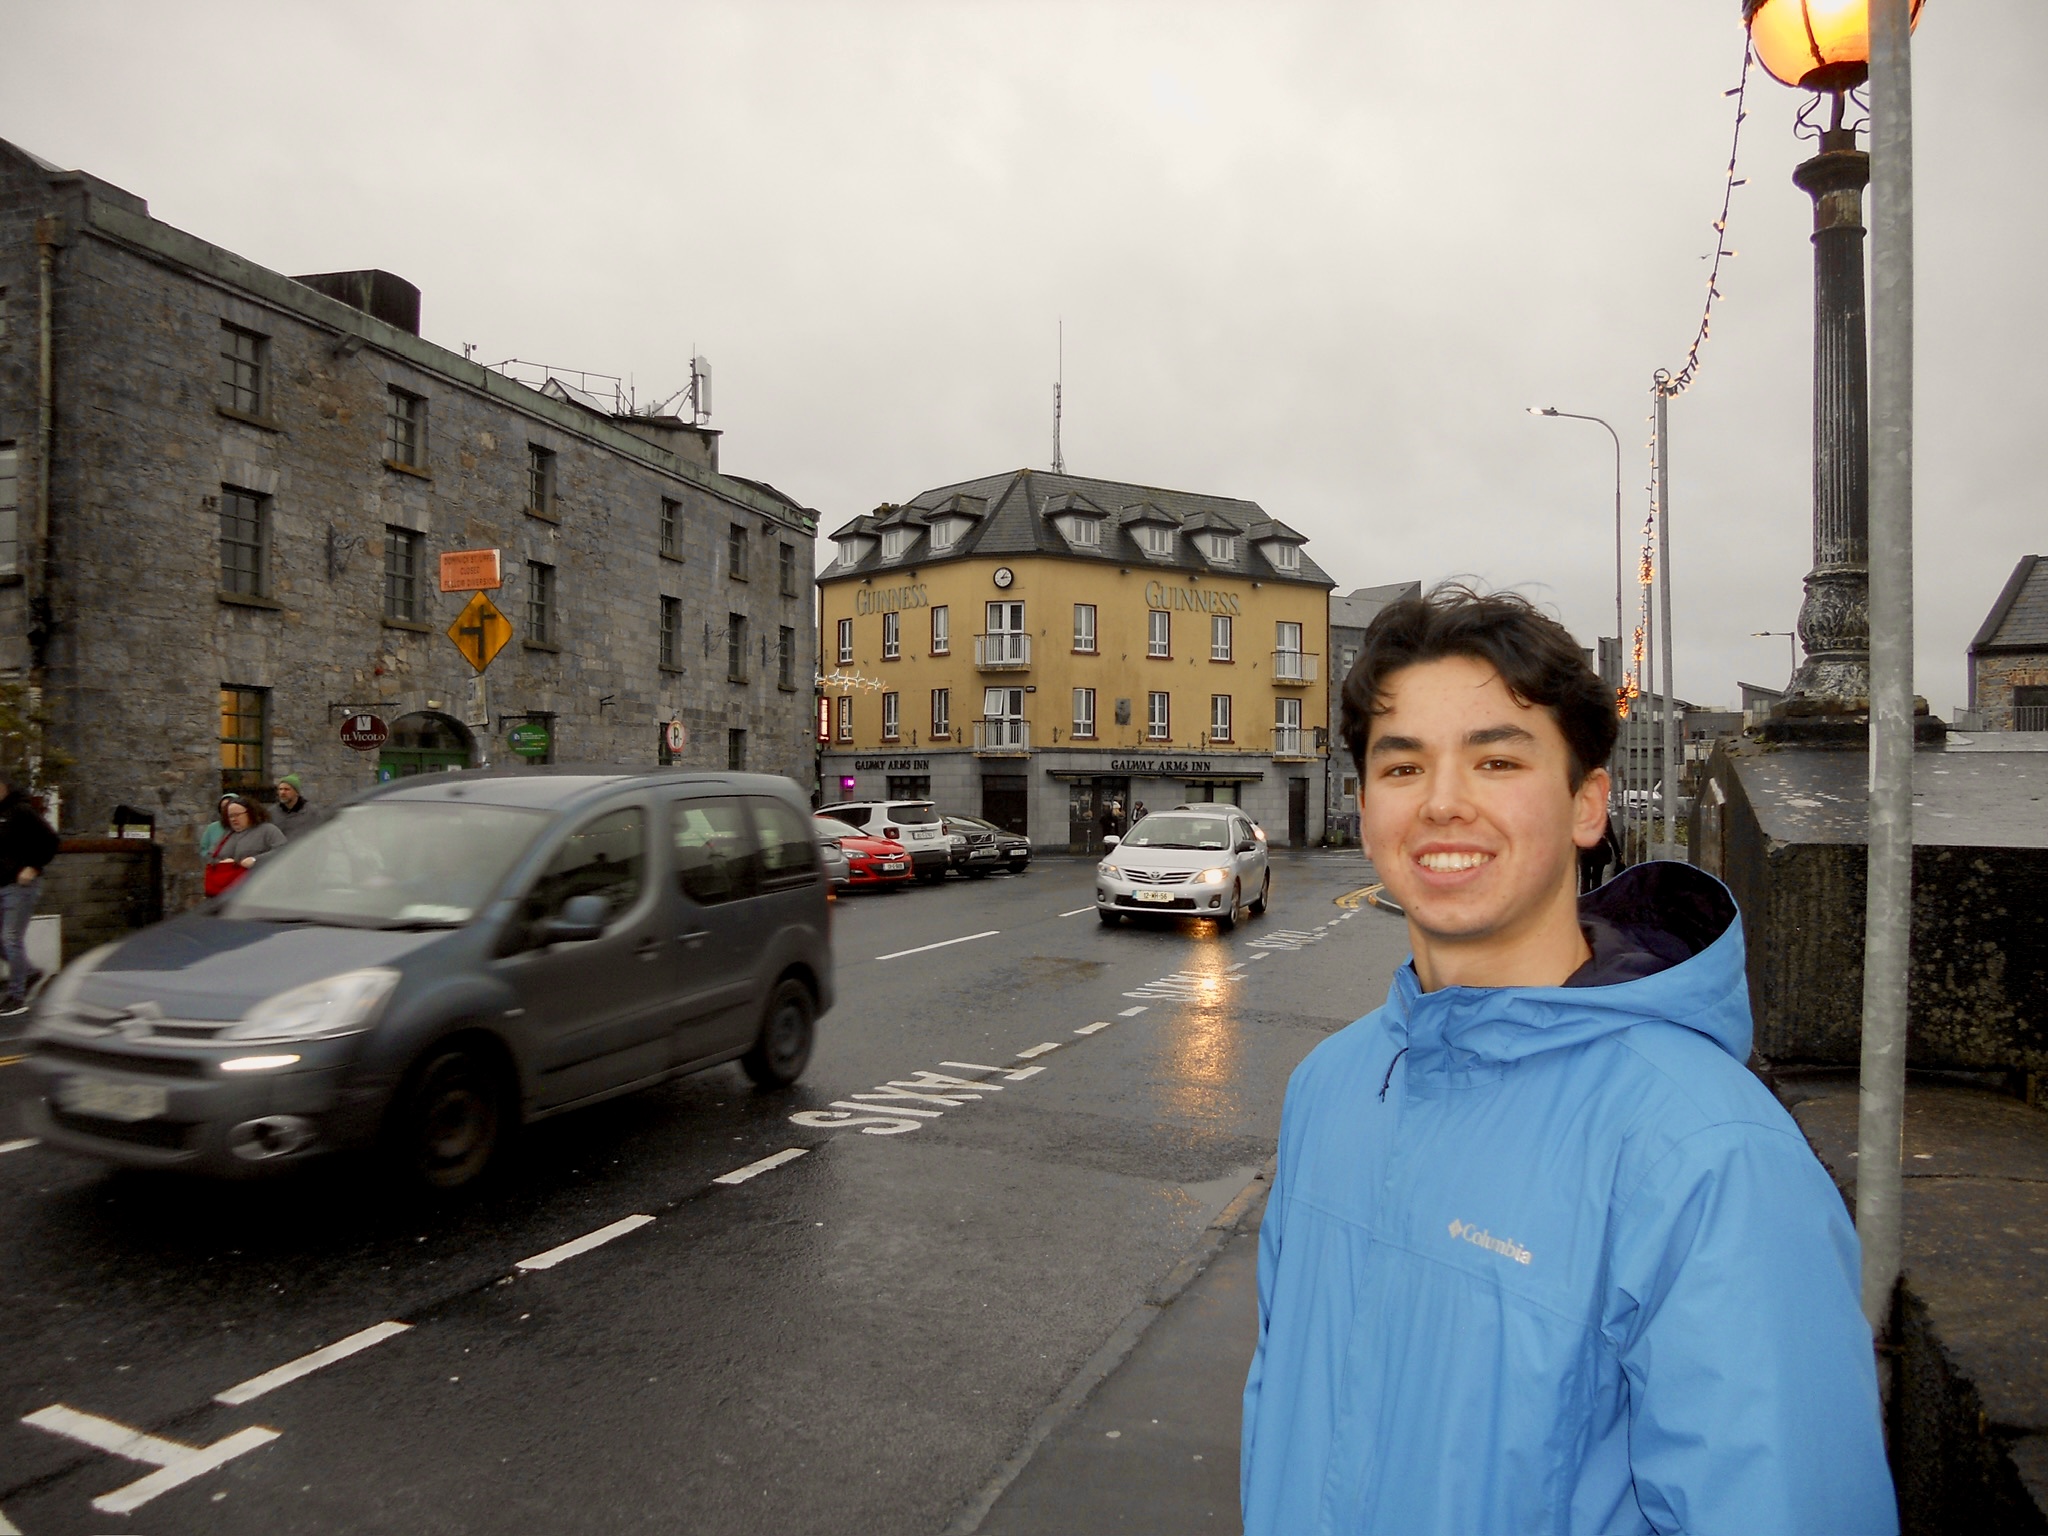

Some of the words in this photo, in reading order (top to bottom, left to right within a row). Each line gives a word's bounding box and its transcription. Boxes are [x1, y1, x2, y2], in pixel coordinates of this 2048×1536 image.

[460, 566, 480, 576] CLOSED
[855, 761, 886, 770] GALWAY
[888, 760, 911, 770] ARMS
[914, 760, 930, 770] INN
[1111, 760, 1154, 770] GALWAY
[1158, 761, 1188, 771] ARMS
[1192, 761, 1211, 771] INN
[1463, 1223, 1532, 1265] Columbia
